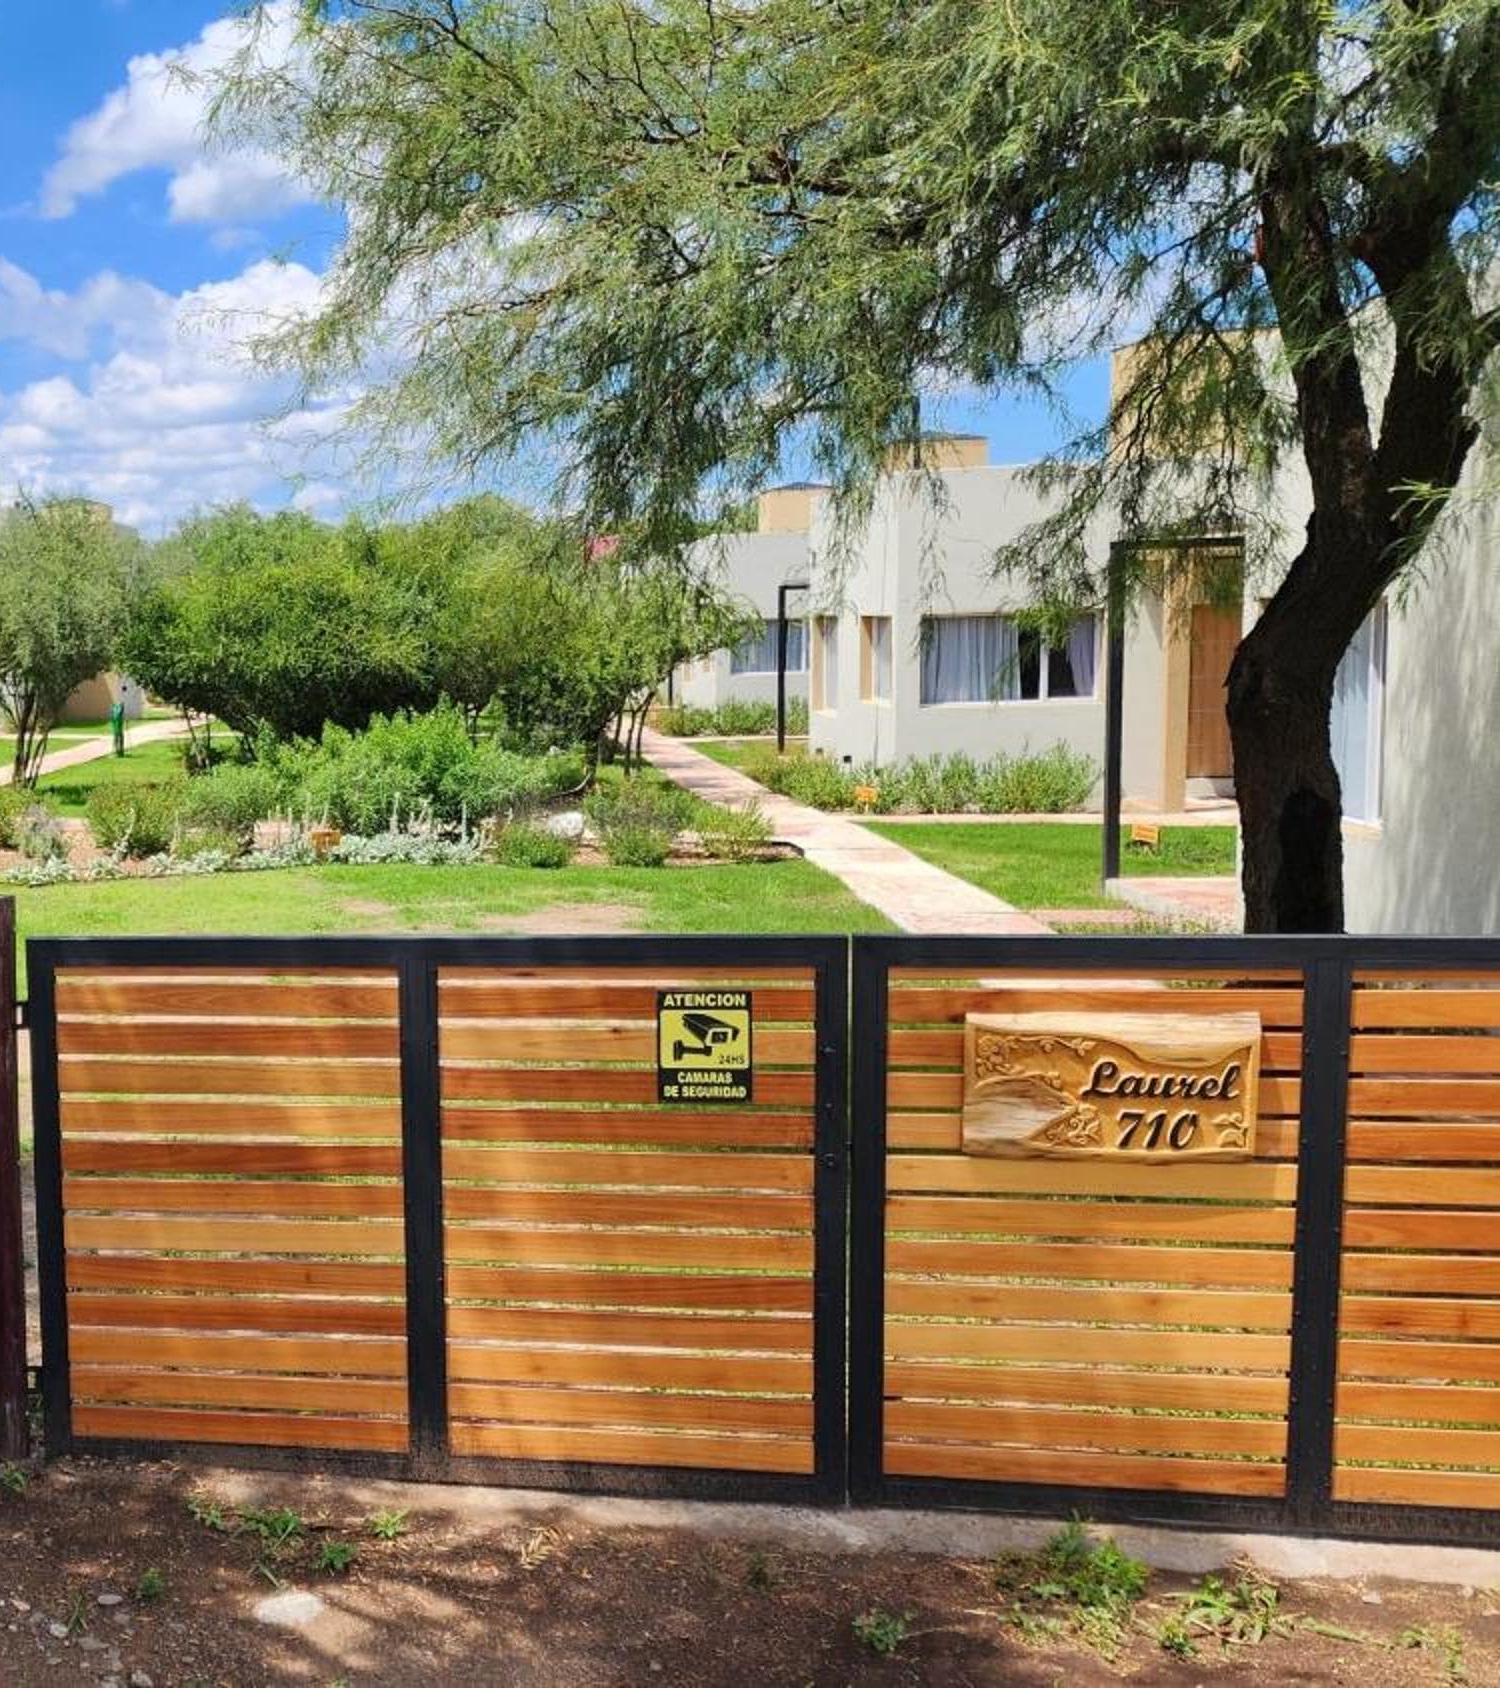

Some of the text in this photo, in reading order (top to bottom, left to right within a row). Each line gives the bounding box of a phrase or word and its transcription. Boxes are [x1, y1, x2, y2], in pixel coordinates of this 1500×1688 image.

[663, 993, 747, 1007] ATENCION
[677, 1071, 733, 1084] CAMARAS
[1080, 1059, 1241, 1100] Laurel
[663, 1085, 747, 1098] DE SEGURIDAD
[1117, 1110, 1198, 1149] 710
